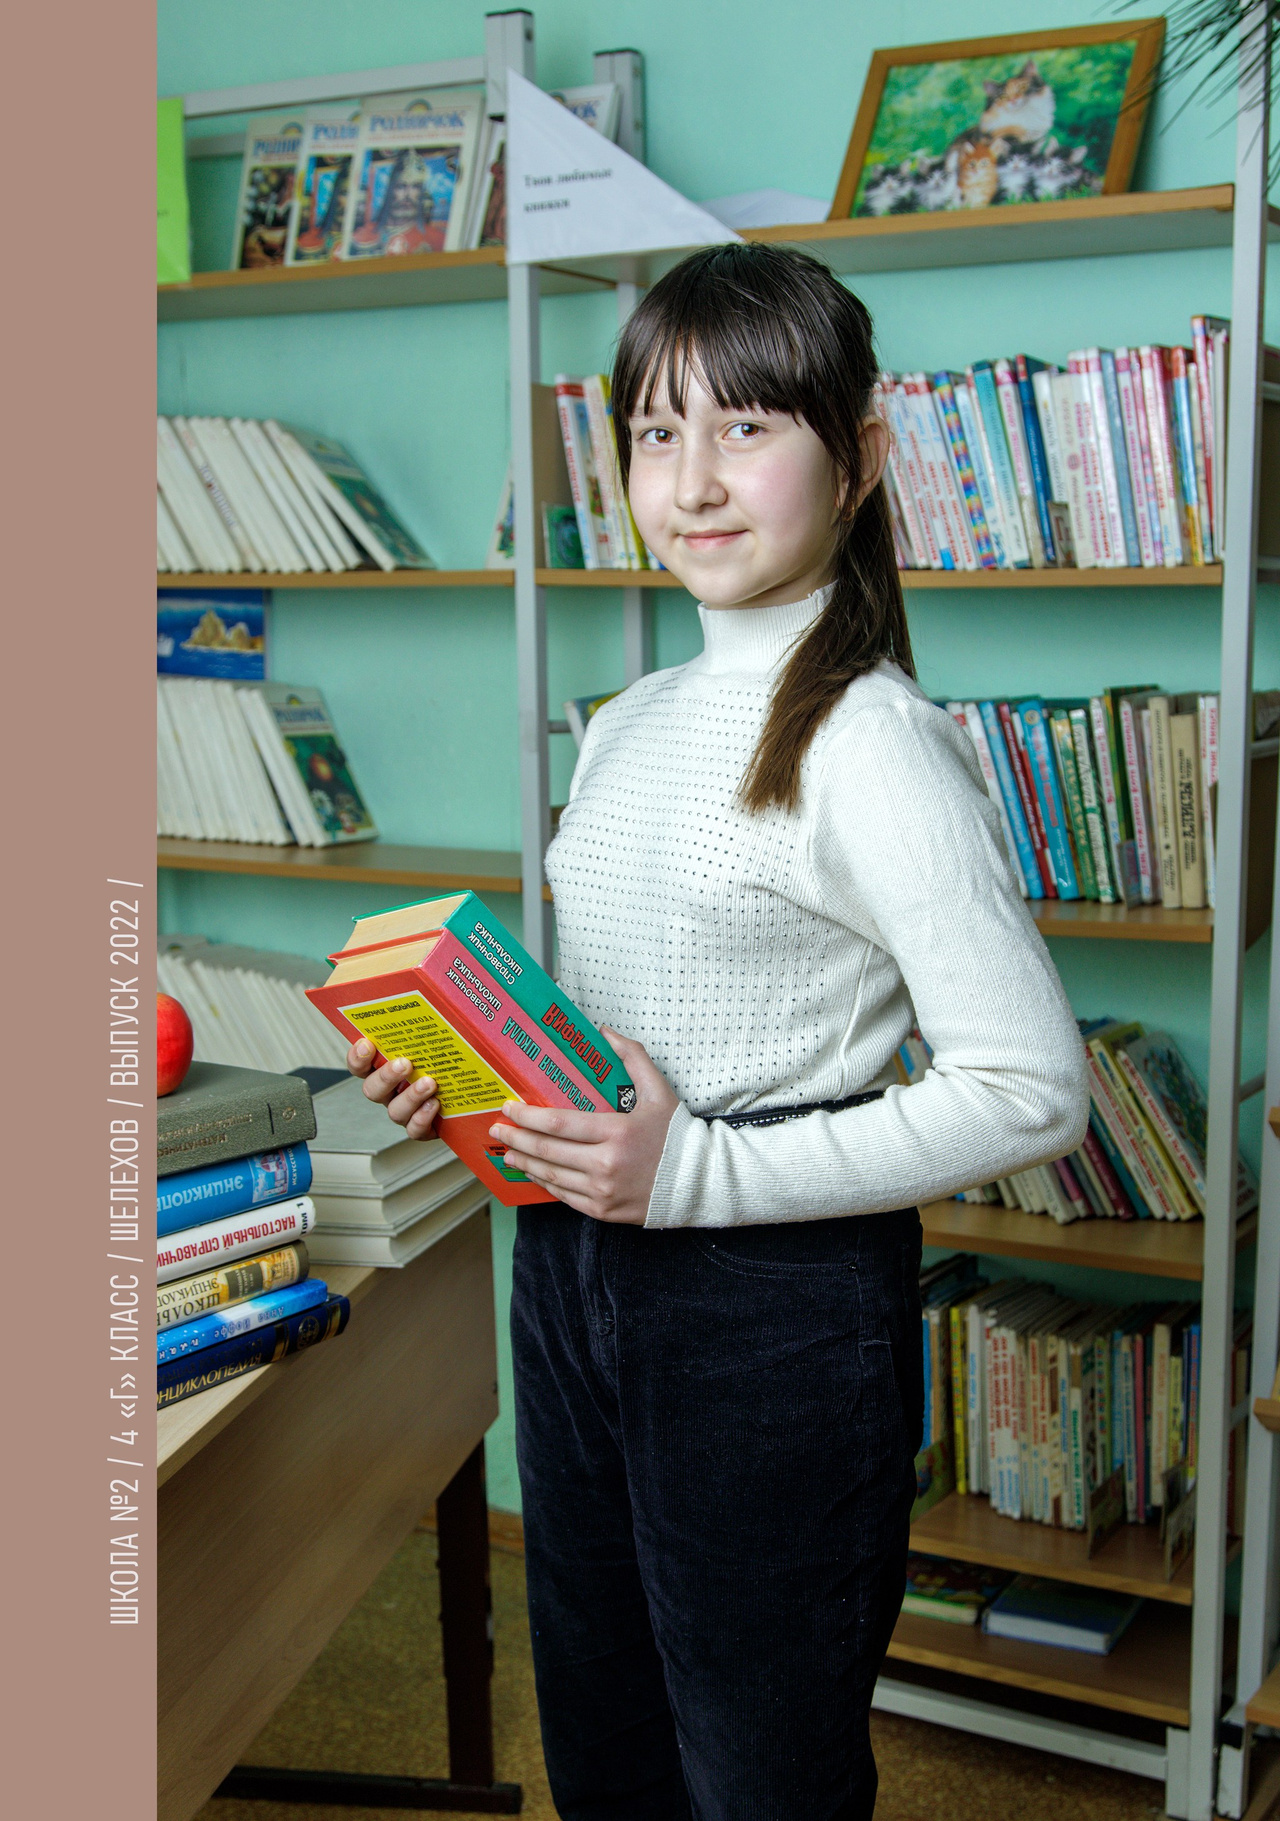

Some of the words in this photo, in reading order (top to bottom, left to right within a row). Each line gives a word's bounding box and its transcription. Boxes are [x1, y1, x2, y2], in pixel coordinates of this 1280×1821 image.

[473, 920, 524, 977] школьника
[452, 956, 503, 1011] школьника
[364, 1020, 408, 1034] НАЧАЛЬНАЯ
[406, 1015, 435, 1026] ШКОЛА
[501, 1016, 541, 1061] ШКОЛА
[541, 1002, 613, 1084] ГЕОГРАФИЯ
[538, 1053, 596, 1113] НАЧАЛЬНАЯ
[296, 1201, 305, 1210] 1
[300, 1212, 308, 1235] ТОМ
[222, 1214, 296, 1250] НАСТОЛЬНЫЙ
[157, 1352, 263, 1406] НЦИКЛОПЕДИЯ
